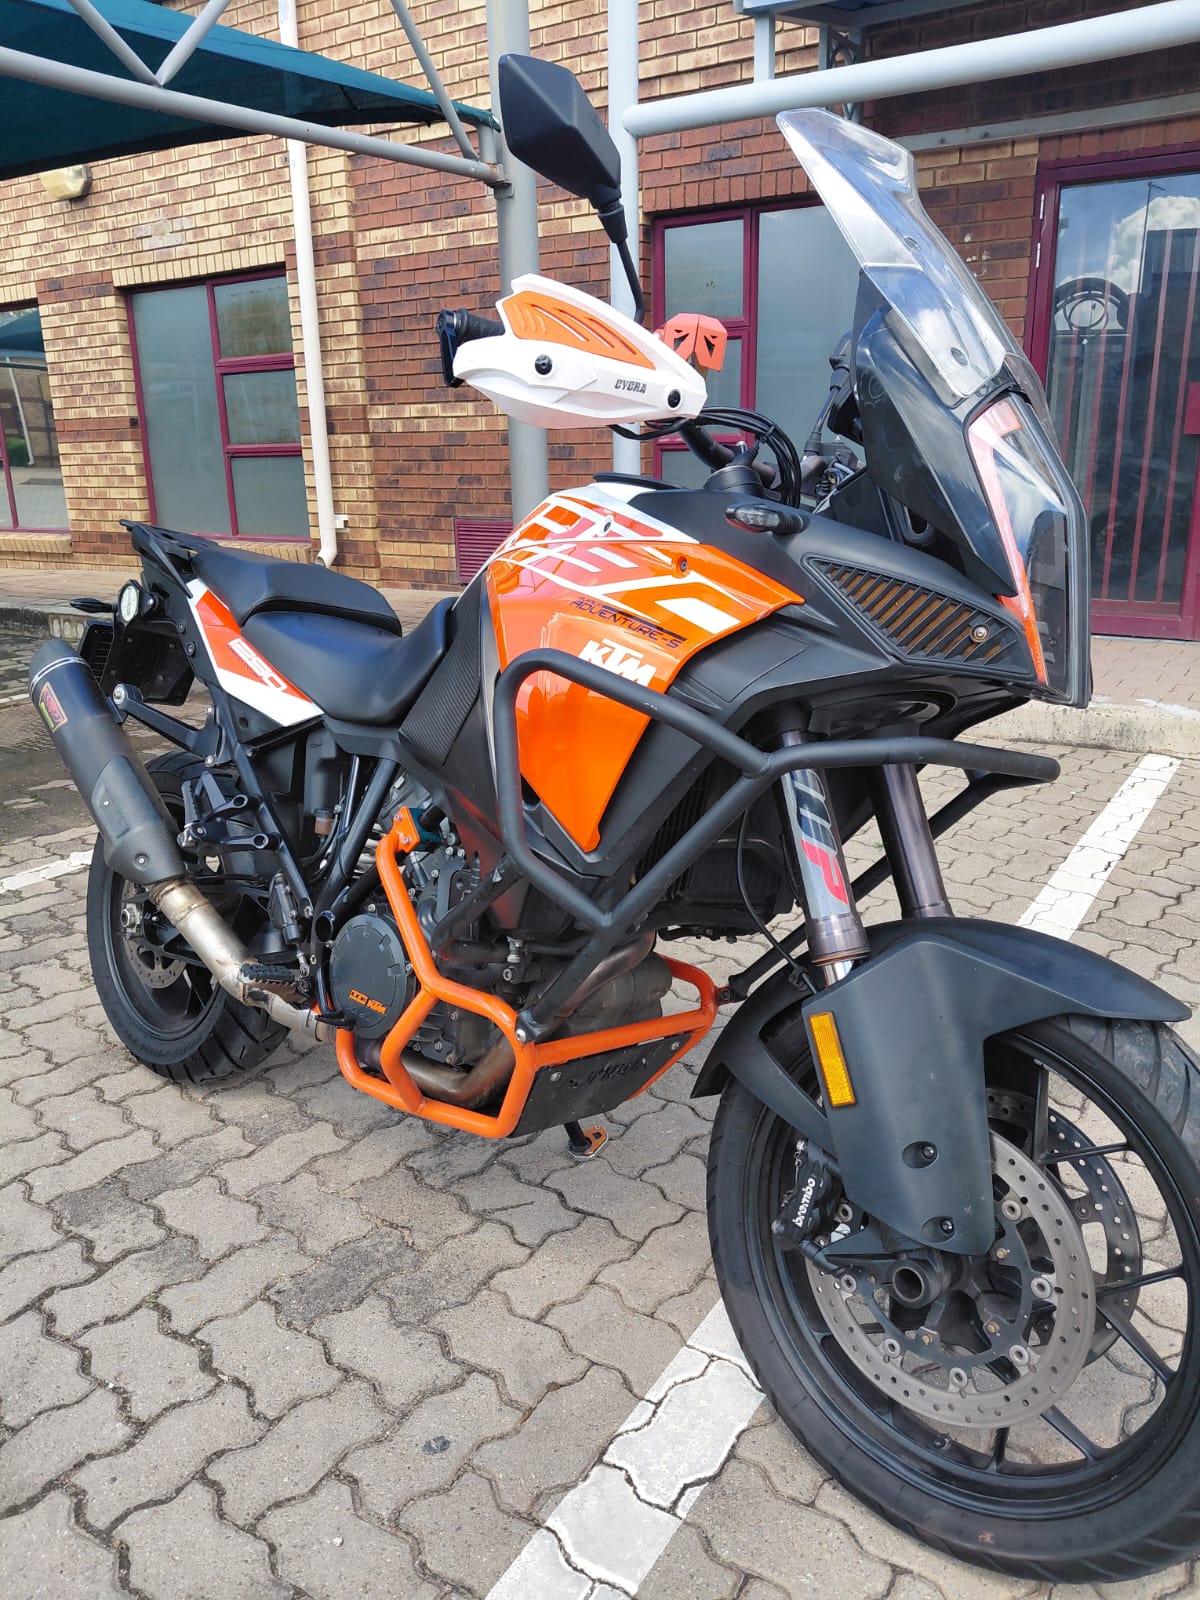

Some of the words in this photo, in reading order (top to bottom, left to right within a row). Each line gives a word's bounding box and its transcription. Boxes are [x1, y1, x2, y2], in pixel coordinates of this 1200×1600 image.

[614, 378, 647, 394] CYCRA
[226, 637, 288, 692] 1290
[578, 638, 657, 687] KTM
[792, 1177, 816, 1228] brembo
